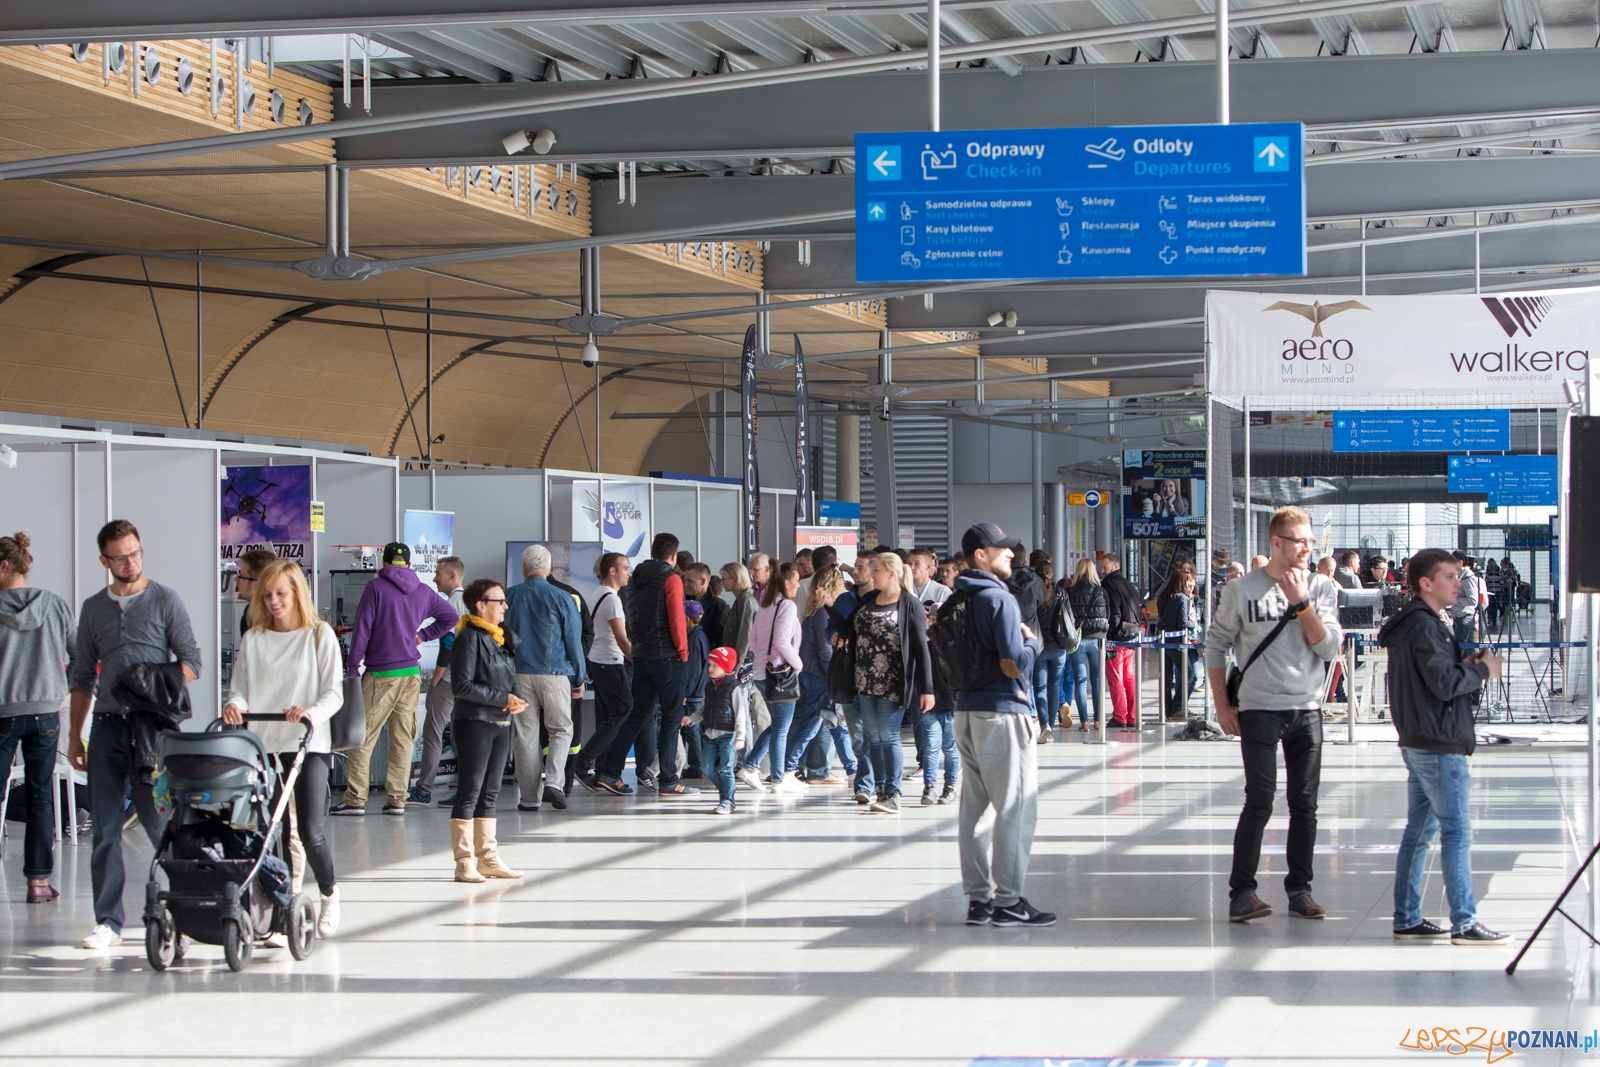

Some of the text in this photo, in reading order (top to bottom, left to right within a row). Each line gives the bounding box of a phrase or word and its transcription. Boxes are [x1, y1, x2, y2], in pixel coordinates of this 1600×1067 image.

[966, 141, 1045, 160] Odprawy
[1133, 137, 1194, 157] Odloty
[966, 162, 1042, 178] Check-in
[1133, 159, 1232, 178] Departures
[925, 198, 1033, 210] Samodzielna odprawa
[1081, 196, 1116, 208] Sklepy
[1186, 193, 1266, 204] Taras widokowy
[925, 223, 995, 236] Kasy biletowe
[1081, 220, 1140, 232] Restauracja
[1186, 218, 1276, 231] Miejsce skupienia
[925, 249, 1004, 261] Zgłoszenie celne
[1081, 245, 1132, 256] Kawiarnia
[1185, 244, 1267, 256] Punkt medyczny
[1281, 338, 1354, 361] aero
[1450, 343, 1589, 373] walkera
[1281, 363, 1354, 375] MIND
[1281, 374, 1355, 385] www.aeromind.pl
[1486, 372, 1553, 382] www.walkera.pl
[1143, 451, 1155, 467] 2
[1154, 451, 1183, 459] dowolne
[1153, 462, 1165, 478] 2
[1165, 466, 1192, 476] napoje
[1132, 522, 1161, 536] 50%
[809, 532, 844, 546] wspia.pl
[235, 544, 244, 559] Z
